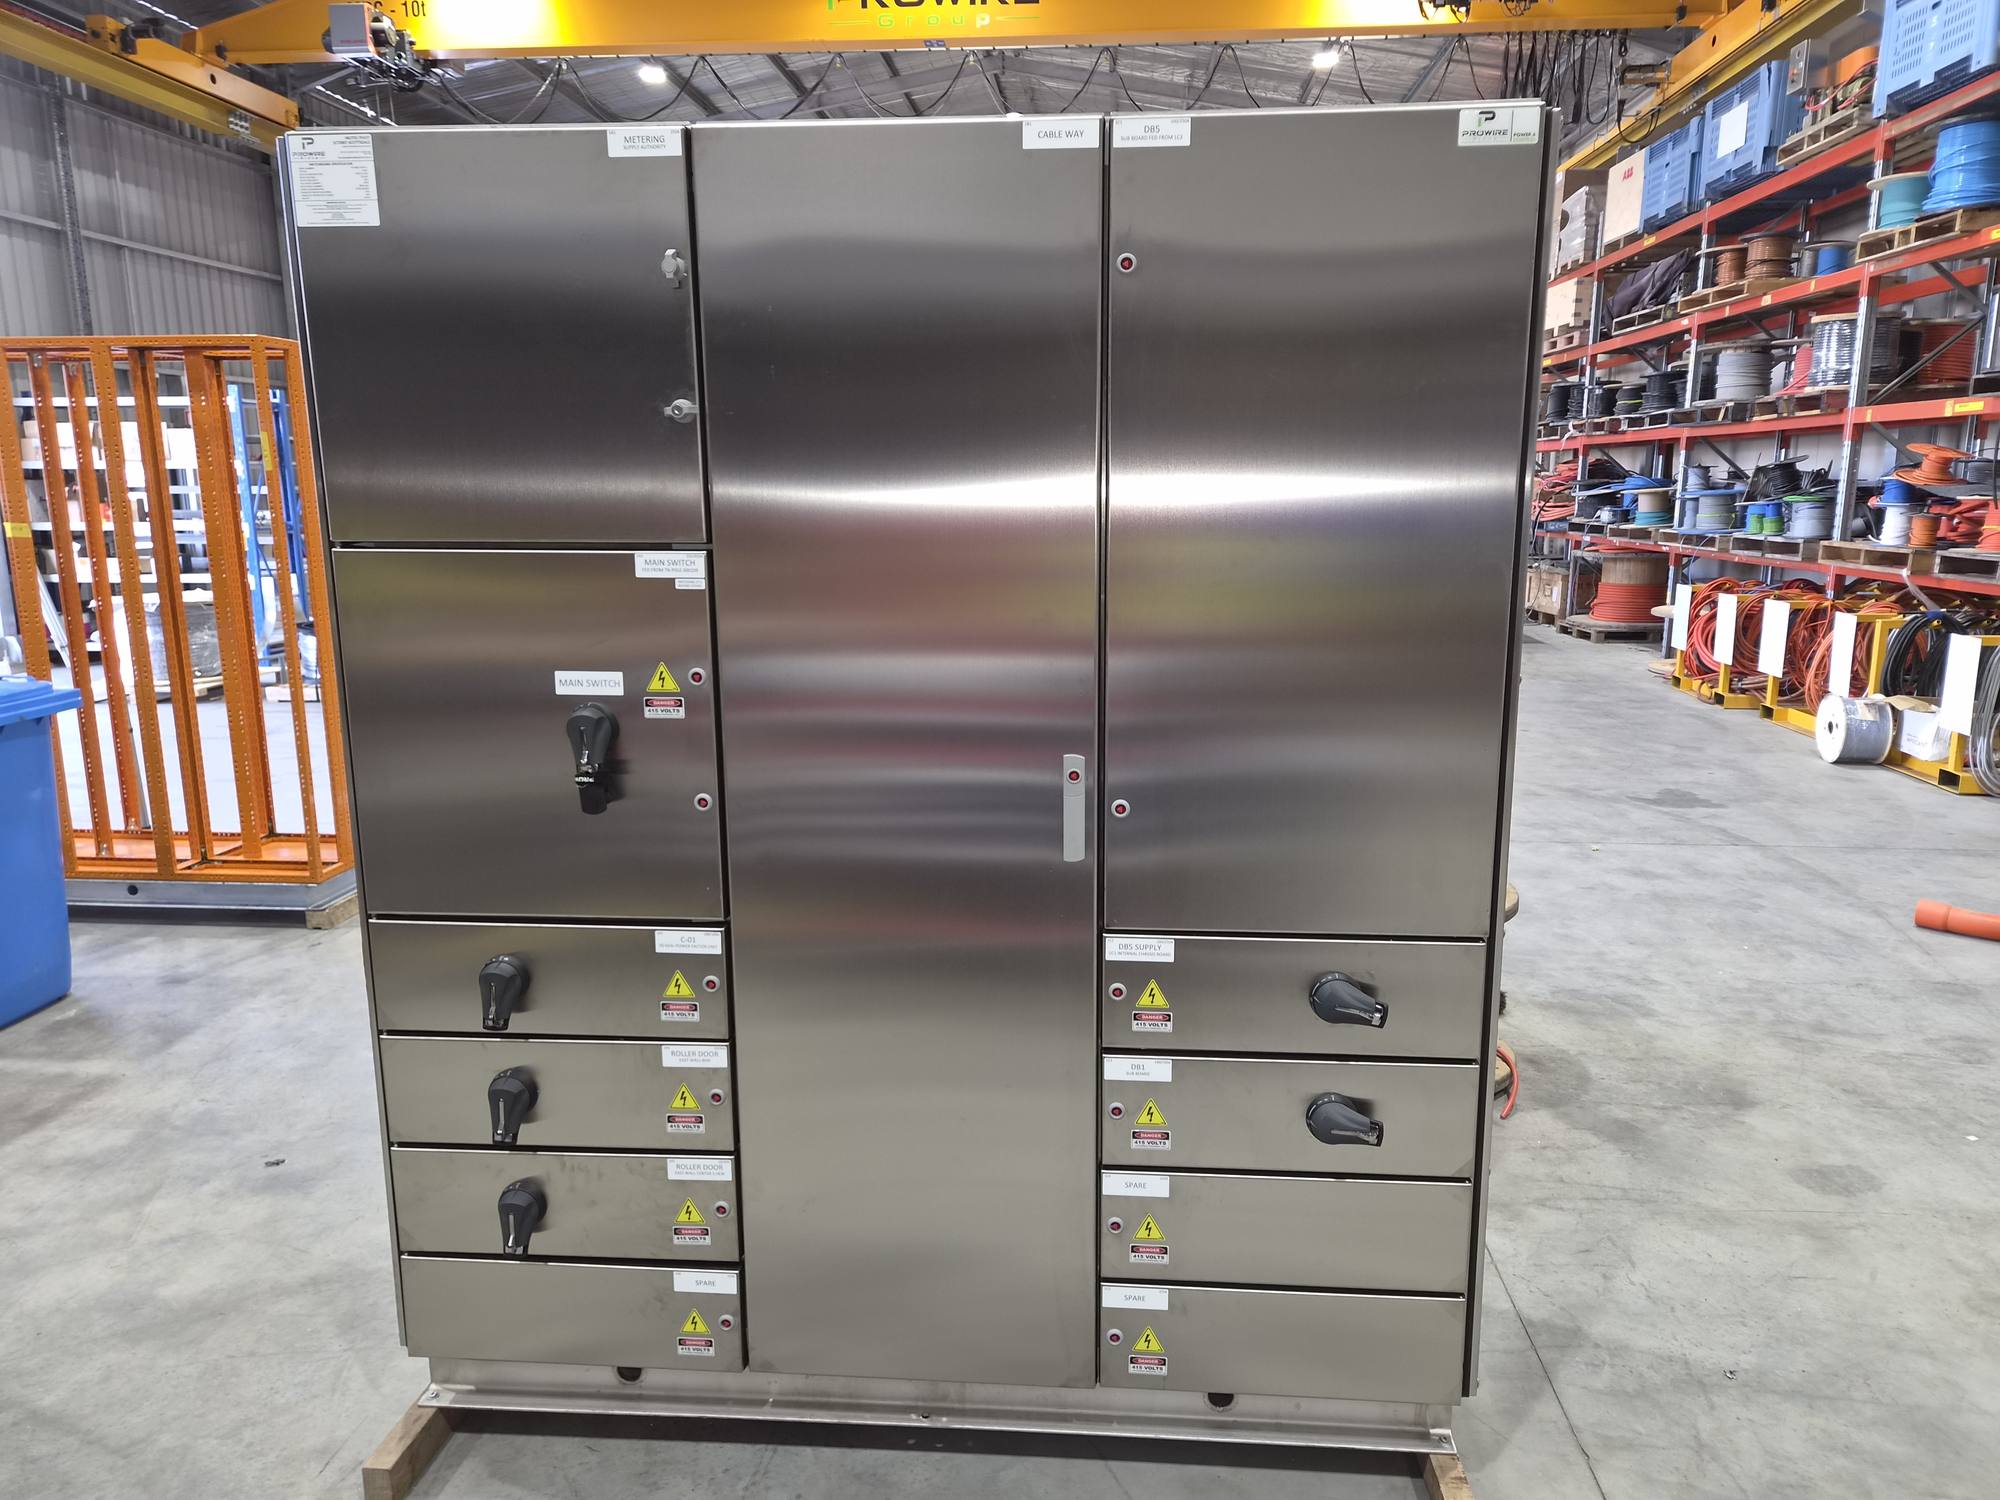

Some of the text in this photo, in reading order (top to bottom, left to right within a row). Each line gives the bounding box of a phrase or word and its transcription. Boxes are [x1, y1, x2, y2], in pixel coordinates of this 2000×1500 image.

[878, 13, 990, 28] Group
[1038, 129, 1084, 139] CABLE WAY
[1462, 129, 1509, 137] PROWIRE
[623, 135, 665, 144] METERING
[559, 679, 621, 688] MAIN SWITCH
[680, 936, 696, 944] C-01
[1130, 1063, 1145, 1071] DB1
[695, 1279, 716, 1287] SPARE
[1124, 1294, 1145, 1302] SPARE
